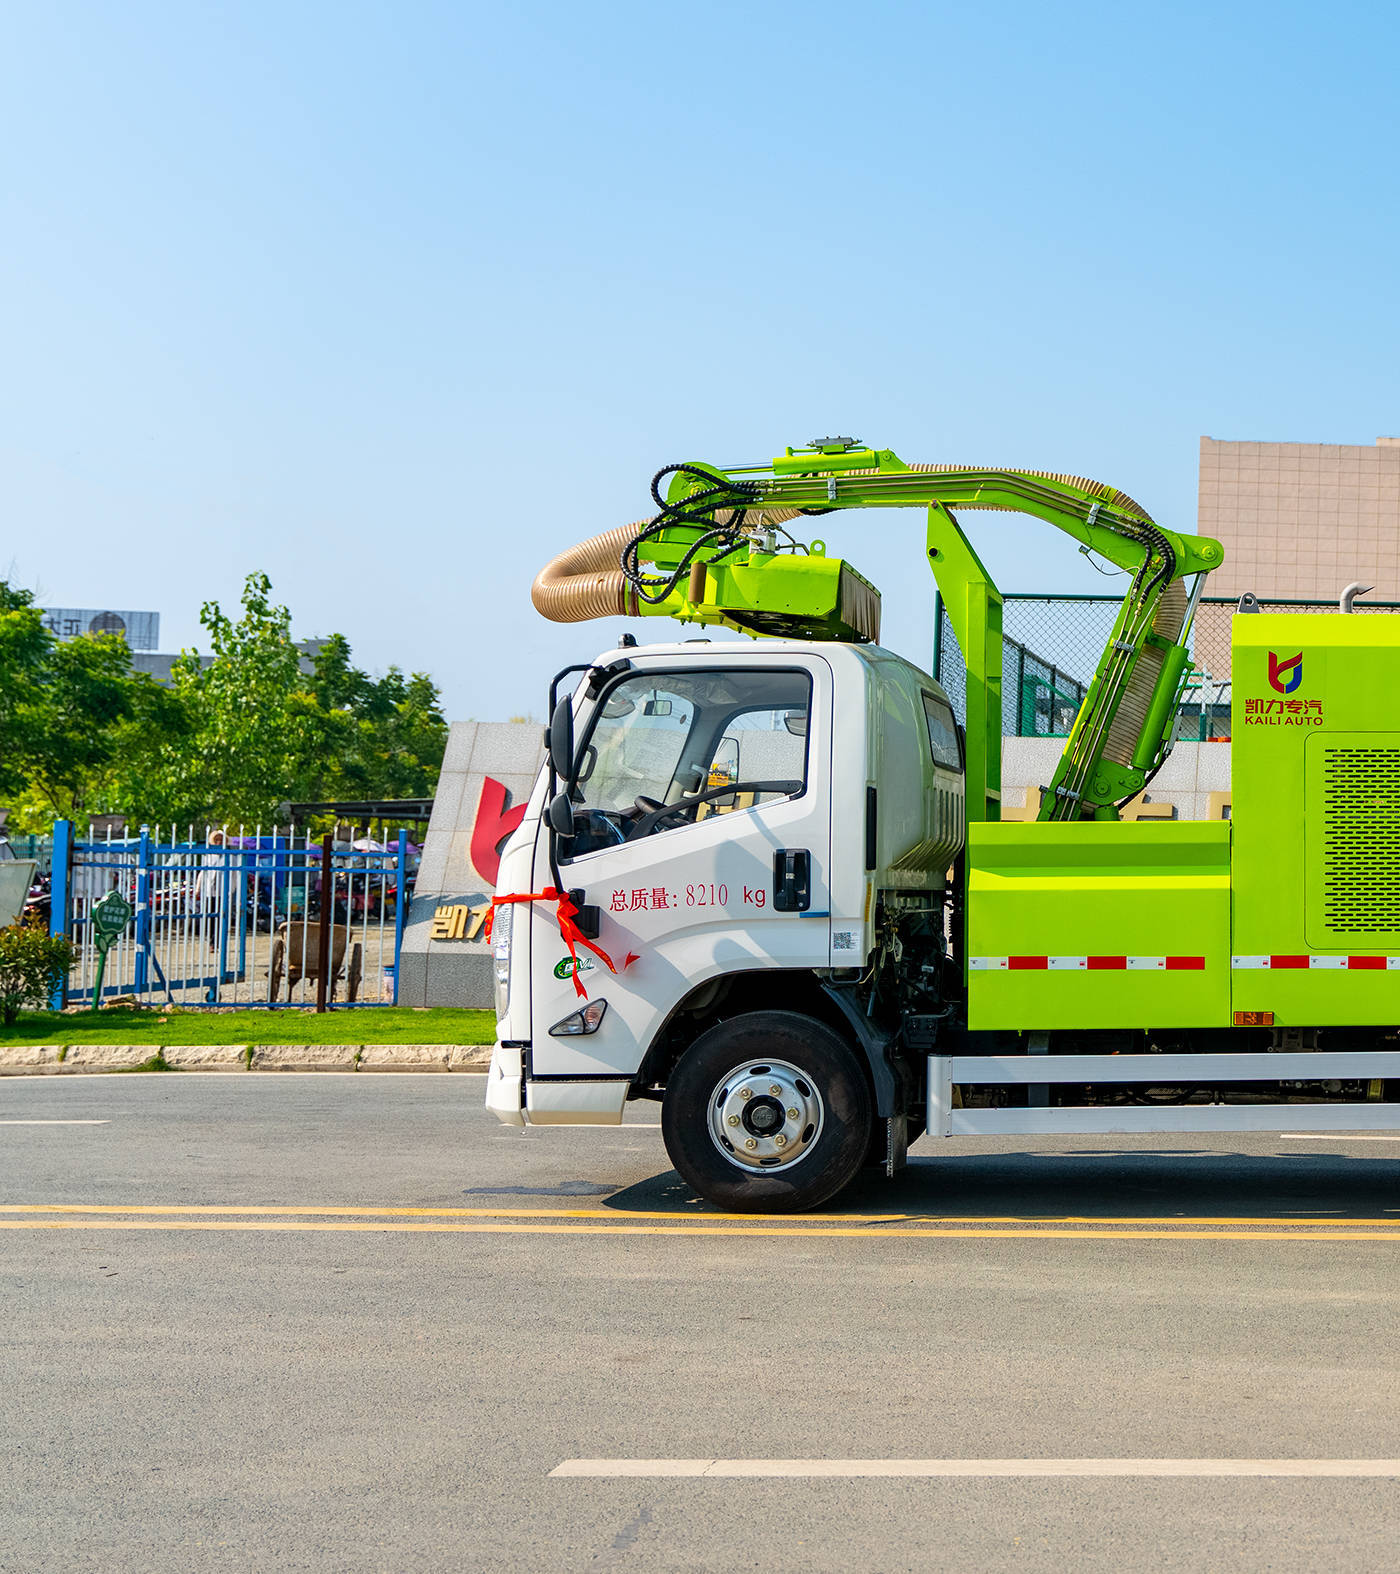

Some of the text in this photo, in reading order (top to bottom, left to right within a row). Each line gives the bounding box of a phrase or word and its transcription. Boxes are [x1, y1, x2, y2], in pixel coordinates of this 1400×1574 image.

[1245, 698, 1323, 715] 凯力专汽
[1245, 716, 1323, 726] KAILI AUTO
[743, 885, 766, 908] kg
